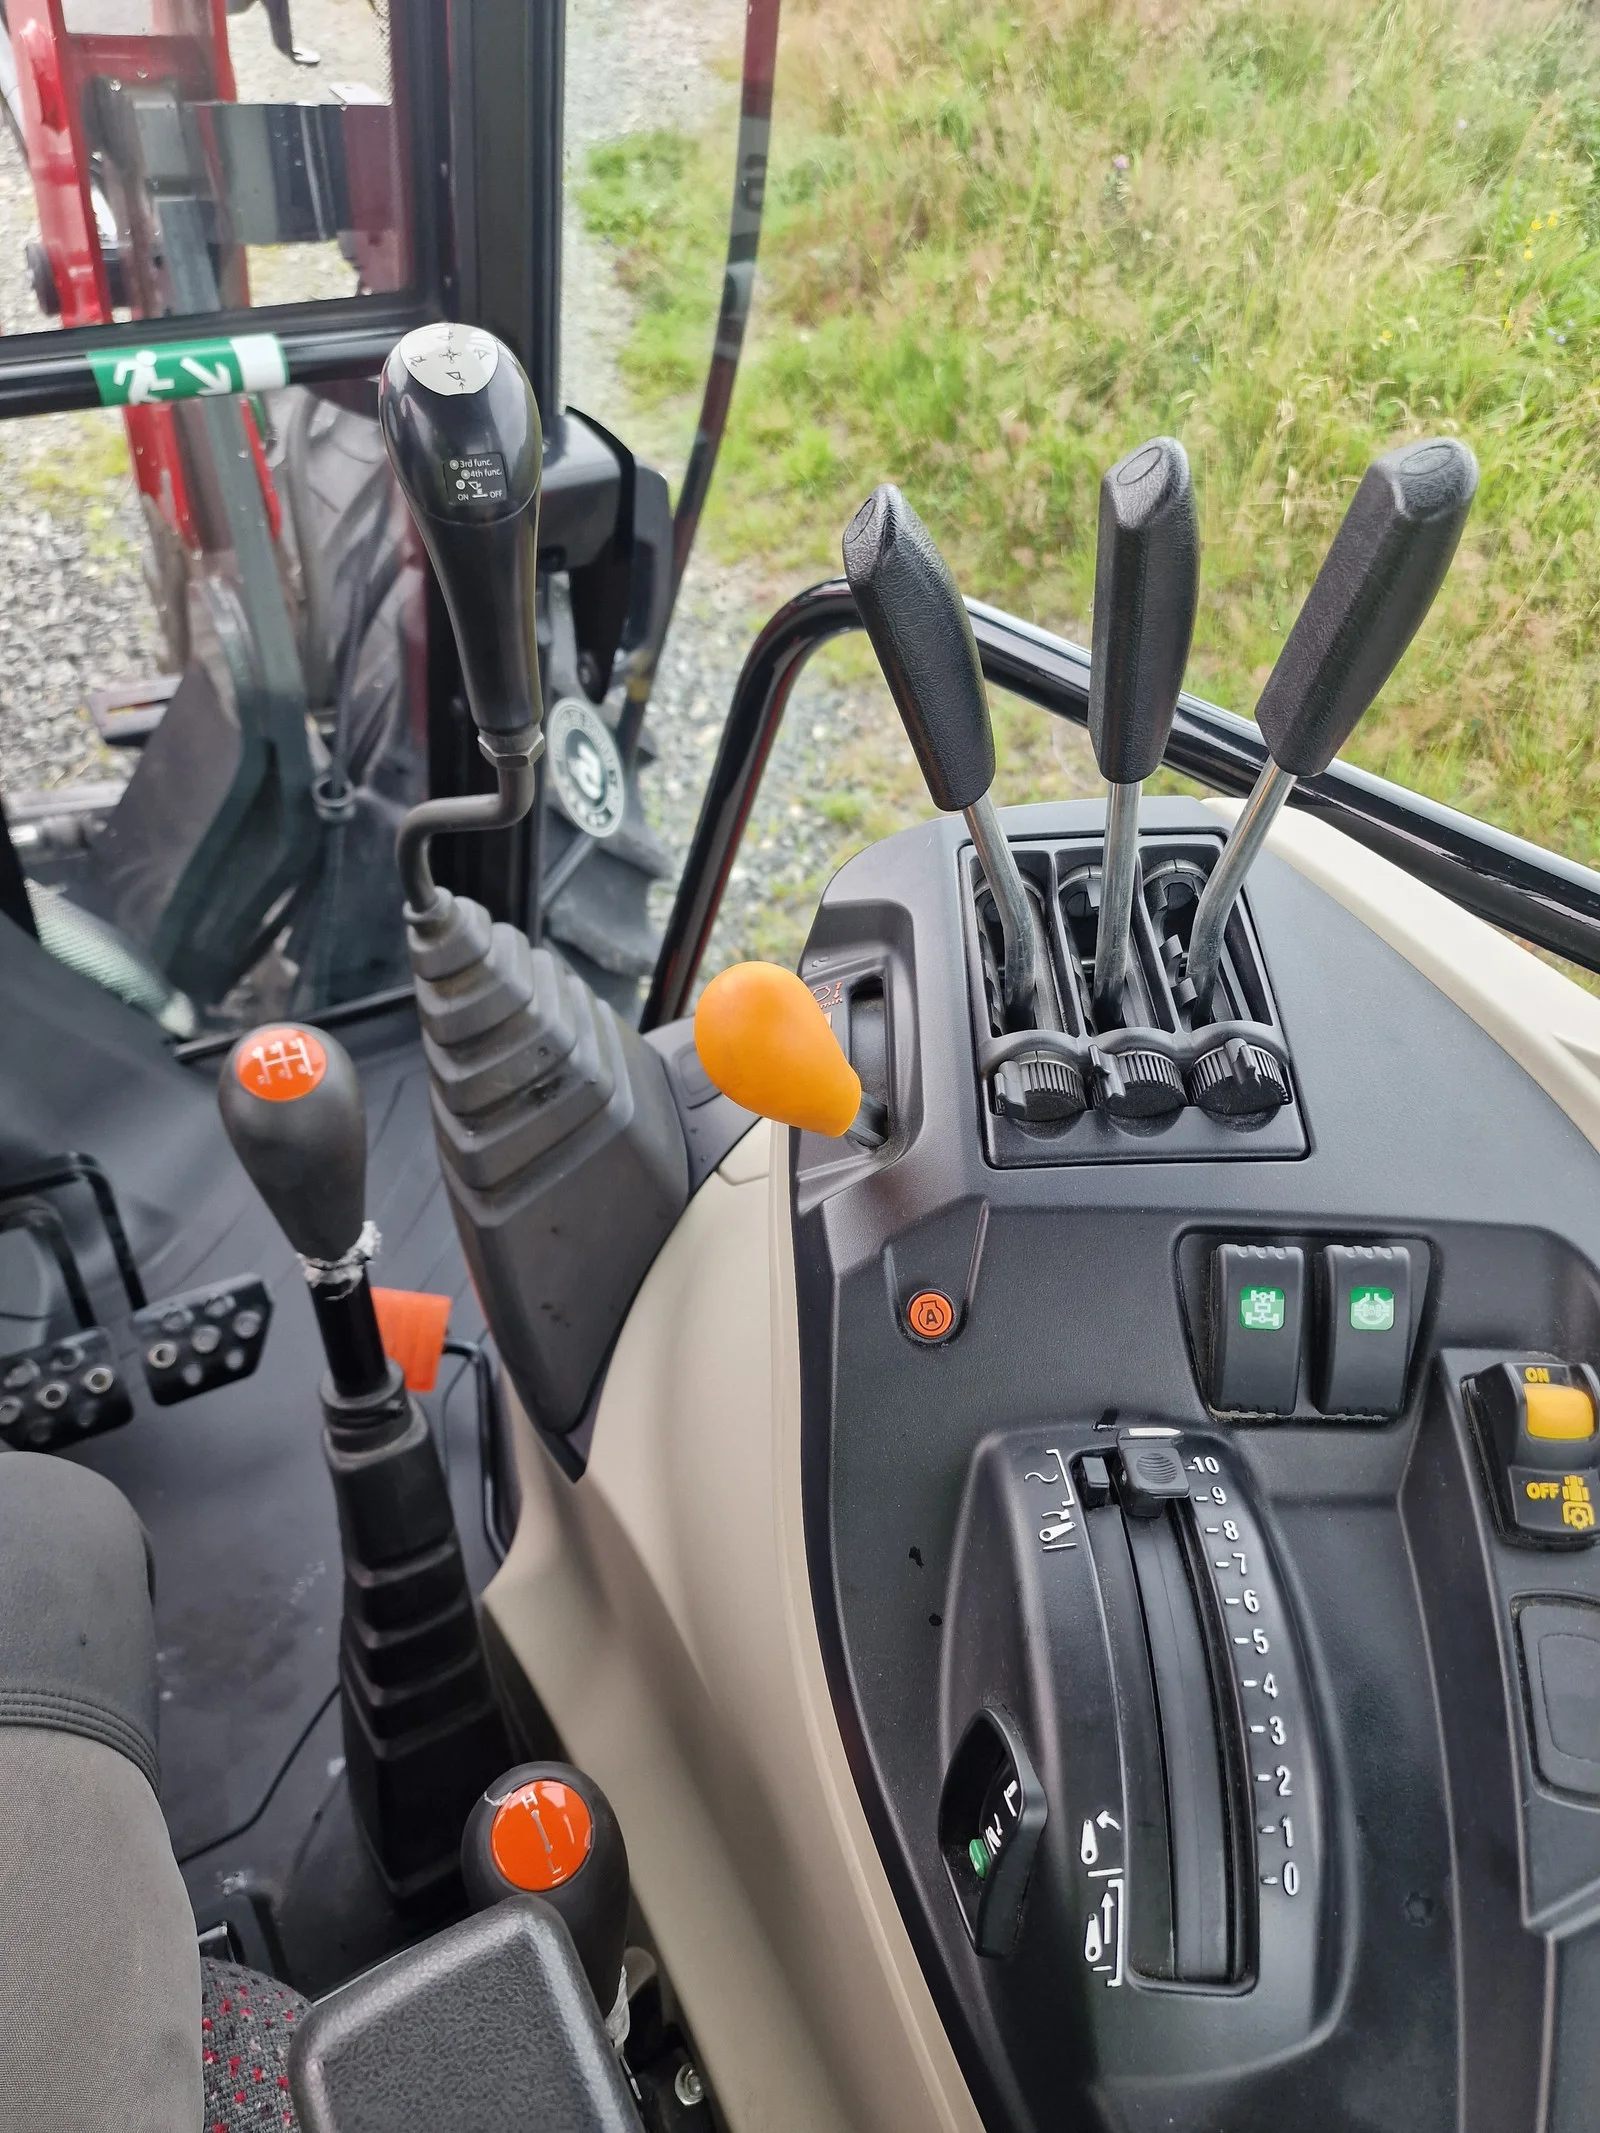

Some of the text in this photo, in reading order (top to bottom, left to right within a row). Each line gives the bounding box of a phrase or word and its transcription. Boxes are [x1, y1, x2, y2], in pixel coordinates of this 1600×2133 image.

[460, 459, 493, 468] 3rd func.
[470, 468, 502, 478] 4th func.
[457, 493, 469, 501] ON
[489, 490, 502, 499] OFF
[925, 1309, 938, 1325] A
[1525, 1367, 1550, 1383] ON
[1192, 1456, 1220, 1474] 10
[1211, 1486, 1227, 1505] 9
[1526, 1482, 1560, 1499] OFF
[1222, 1519, 1239, 1541] 8
[1232, 1552, 1247, 1575] 7
[1243, 1589, 1260, 1613] 6
[1252, 1628, 1270, 1655] 5
[1263, 1672, 1279, 1699] 4
[1269, 1715, 1287, 1745] 3
[1276, 1765, 1293, 1796] 2
[521, 1791, 538, 1810] H
[1281, 1816, 1294, 1848] 1
[1283, 1861, 1299, 1896] 0
